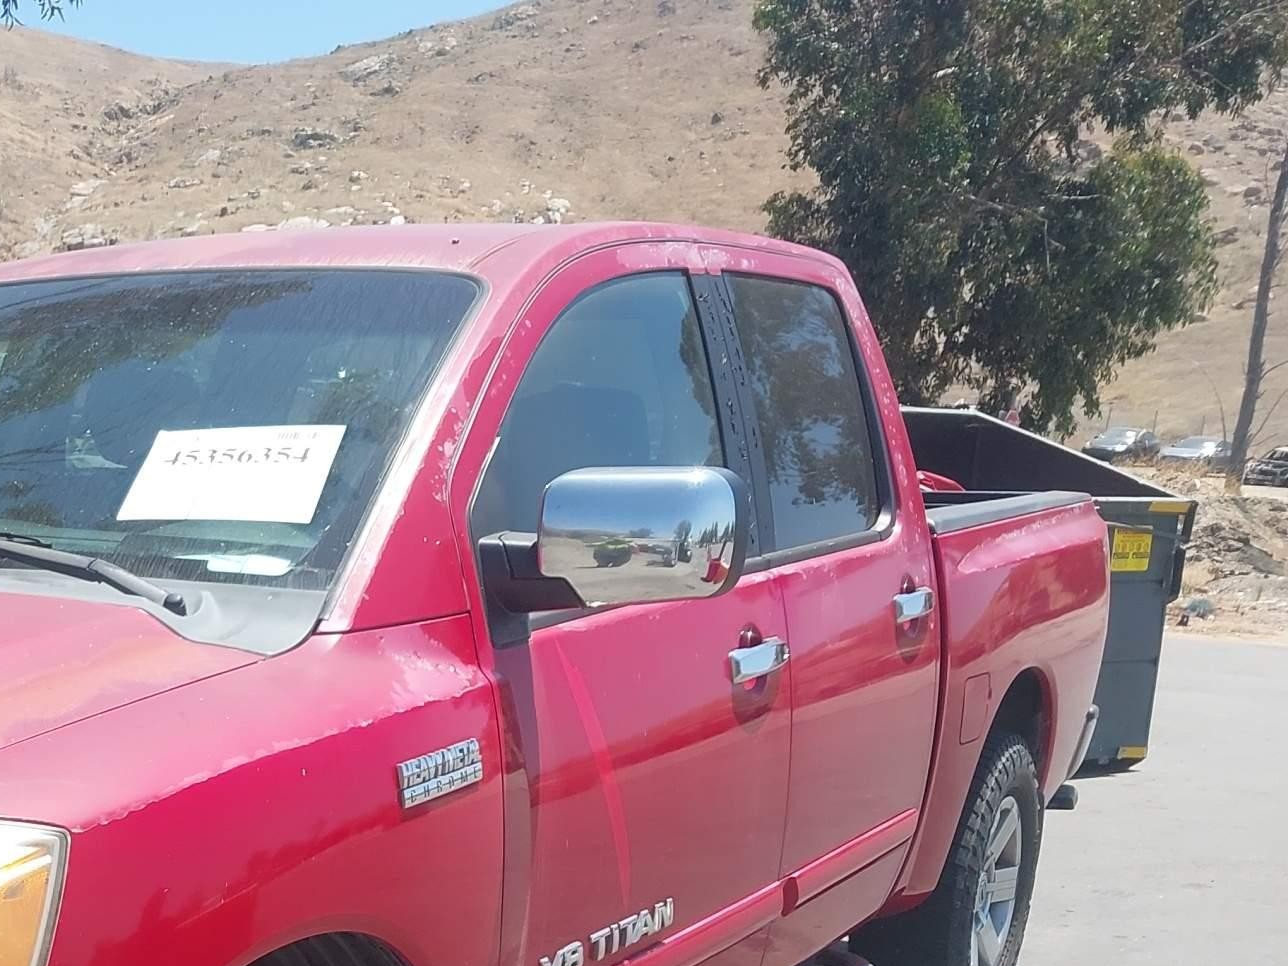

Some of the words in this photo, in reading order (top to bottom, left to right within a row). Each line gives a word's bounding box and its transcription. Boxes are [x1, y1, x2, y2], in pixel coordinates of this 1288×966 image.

[160, 446, 312, 465] 45356354
[409, 765, 481, 804] CHROME
[589, 897, 674, 961] TITAN
